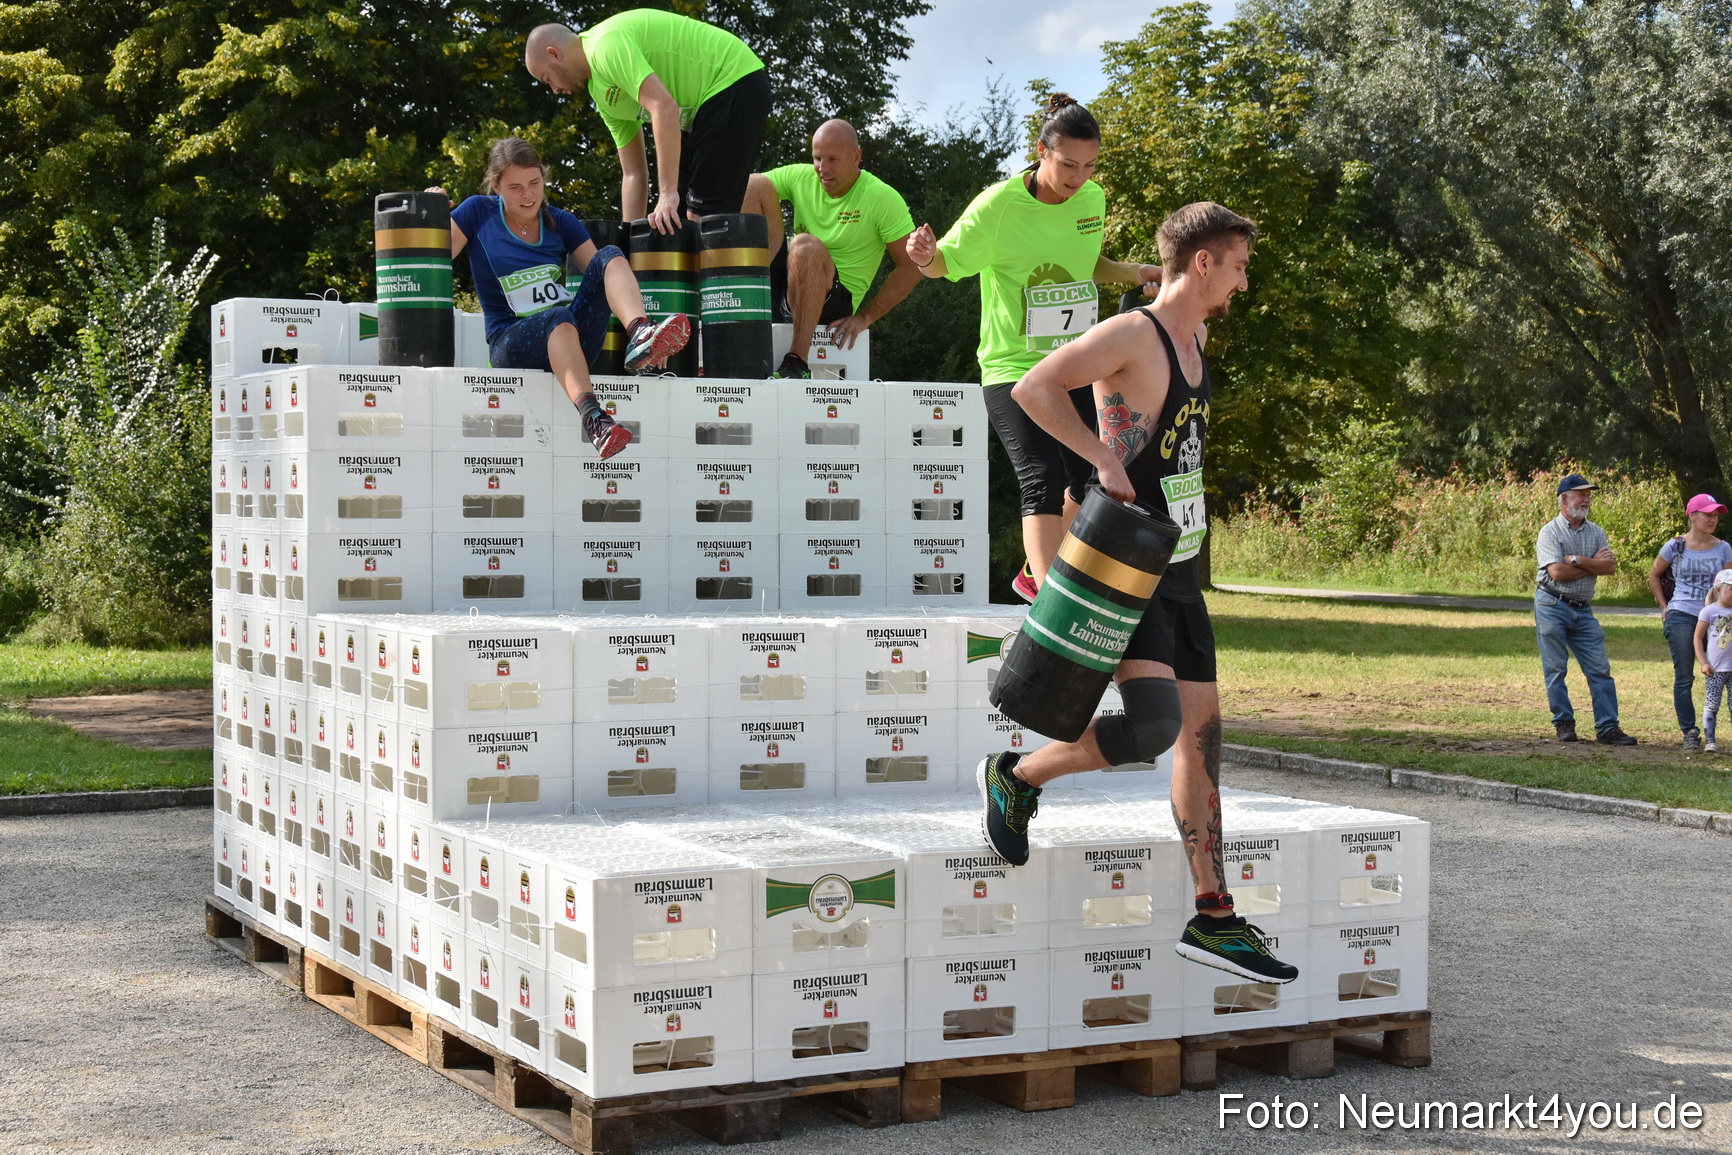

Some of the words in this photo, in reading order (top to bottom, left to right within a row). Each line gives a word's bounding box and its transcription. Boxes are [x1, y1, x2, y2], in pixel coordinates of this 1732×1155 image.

[378, 274, 411, 283] Neumarkter
[533, 283, 559, 303] 40
[1031, 285, 1093, 305] BOCK
[263, 307, 320, 317] Lammsbräu
[1061, 309, 1074, 330] 7
[339, 374, 400, 385] Lammsbräu
[464, 375, 523, 387] Lammsbräu
[347, 384, 393, 393] Neumarkter
[472, 385, 516, 395] Neumarkter
[592, 384, 639, 394] Lammsbr
[696, 386, 751, 397] Lammsbräu
[806, 387, 858, 399] Lammsbräu
[913, 389, 963, 399] Lammsbräu
[703, 395, 743, 404] Neumarkter
[813, 397, 851, 405] Neumarkter
[919, 398, 956, 407] Neumarkter
[339, 456, 400, 467] Lammsbräu
[464, 457, 523, 468] Lammsbräu
[583, 462, 640, 472] Lammsbräu
[347, 466, 393, 475] Neumarkter
[472, 466, 516, 475] Neumarkter
[697, 463, 751, 473] Lammsbräu
[807, 463, 859, 474] Lammsbräu
[914, 464, 963, 474] Lammsbräu
[591, 471, 632, 480] Neumarkter
[704, 472, 744, 481] Neumarkter
[813, 472, 852, 480] Neumarkter
[920, 473, 956, 481] Neumarkter
[1171, 475, 1203, 497] BOCK
[1182, 502, 1195, 529] 41
[339, 538, 400, 549] Lammsbräu
[464, 538, 523, 549] Lammsbräu
[583, 540, 640, 551] Lammsbräu
[697, 541, 751, 551] Lammsbräu
[808, 538, 860, 549] Lammsbräu
[914, 538, 964, 548] Lammsbräu
[1178, 535, 1200, 551] NIKLAS
[347, 547, 393, 556] Neumarkter
[472, 547, 516, 557] Neumarkter
[591, 549, 632, 558] Neumarkter
[704, 550, 744, 558] Neumarkter
[814, 547, 853, 556] Neumarkter
[920, 548, 957, 556] Neumarkter
[1681, 558, 1717, 573] JUST
[867, 628, 927, 640] Lammsbräu
[1086, 618, 1131, 640] Neumarkter
[609, 634, 675, 646] Lammsbräu
[742, 632, 804, 643] Lammsbräu
[1069, 622, 1128, 652] Lammsbrä
[468, 638, 538, 649] Lammsbräu
[750, 643, 797, 652] Neumarkter
[874, 639, 918, 648] Neumarkter
[477, 649, 528, 659] Neumarkter
[618, 646, 666, 654] Neumarkter
[867, 715, 927, 726] Lammsbräu
[609, 725, 675, 737] Lammsbräu
[741, 721, 804, 732] Lammsbräu
[875, 726, 918, 735] Neumarkter
[468, 731, 538, 743] Lammsbräu
[618, 737, 666, 746] Neumarkter
[749, 732, 796, 741] Neumarkter
[477, 743, 528, 753] Neumarkter
[1341, 830, 1400, 844] Lammsbräu
[1224, 839, 1279, 854] Lammsbrä
[1349, 843, 1392, 853] Neumarkter
[1085, 847, 1151, 862] Lammsbräu
[1224, 853, 1270, 863] Neumarkter
[946, 857, 1015, 870] ammsbräu
[1093, 861, 1142, 871] Neumarkter
[954, 870, 1005, 880] Neumarkter
[634, 877, 713, 894] Lammsbräu
[645, 892, 702, 904] Neumarkter
[1340, 925, 1399, 940] Lammsbräu
[1348, 938, 1391, 948] Neumarkter
[1085, 948, 1151, 962] Lammsbräu
[946, 959, 1016, 973] Lammsbräu
[1093, 961, 1142, 972] Neumarkter
[793, 974, 867, 990] Lammsbräu
[954, 971, 1006, 983] Neumarkter
[633, 986, 712, 1003] Lammsbräu
[803, 988, 857, 1000] Neumarkter
[644, 1000, 701, 1014] Neumarkter
